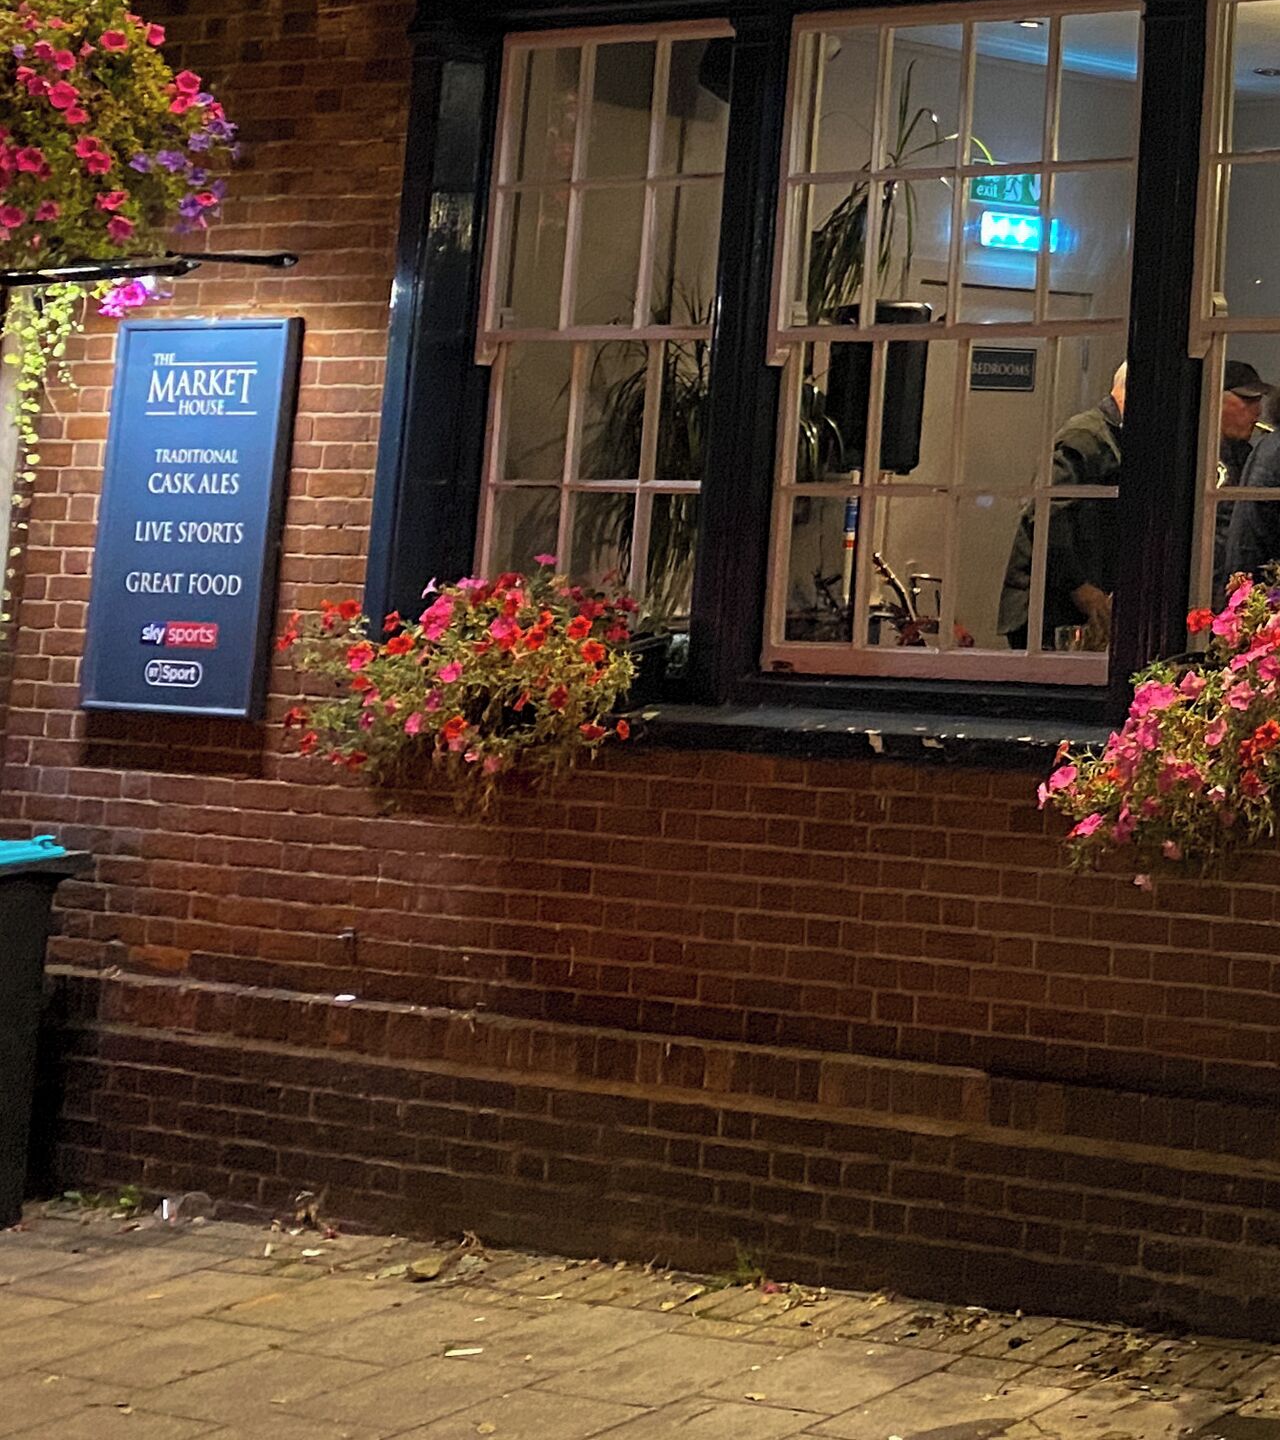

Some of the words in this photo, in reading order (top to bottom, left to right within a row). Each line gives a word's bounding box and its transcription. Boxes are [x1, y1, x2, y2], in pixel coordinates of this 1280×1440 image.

[976, 182, 998, 198] exit
[153, 352, 176, 366] THE
[147, 368, 257, 405] MARKET
[178, 399, 225, 416] HOUSE
[154, 448, 239, 464] TRADITIONAL
[148, 472, 195, 495] CASK
[197, 472, 241, 496] ALES
[134, 520, 173, 543] LIVE
[177, 521, 244, 544] SPORTS
[125, 571, 184, 594] GREAT
[186, 572, 242, 596] FOOD
[142, 623, 165, 645] sky
[168, 625, 215, 645] sports
[162, 664, 196, 682] Sport
